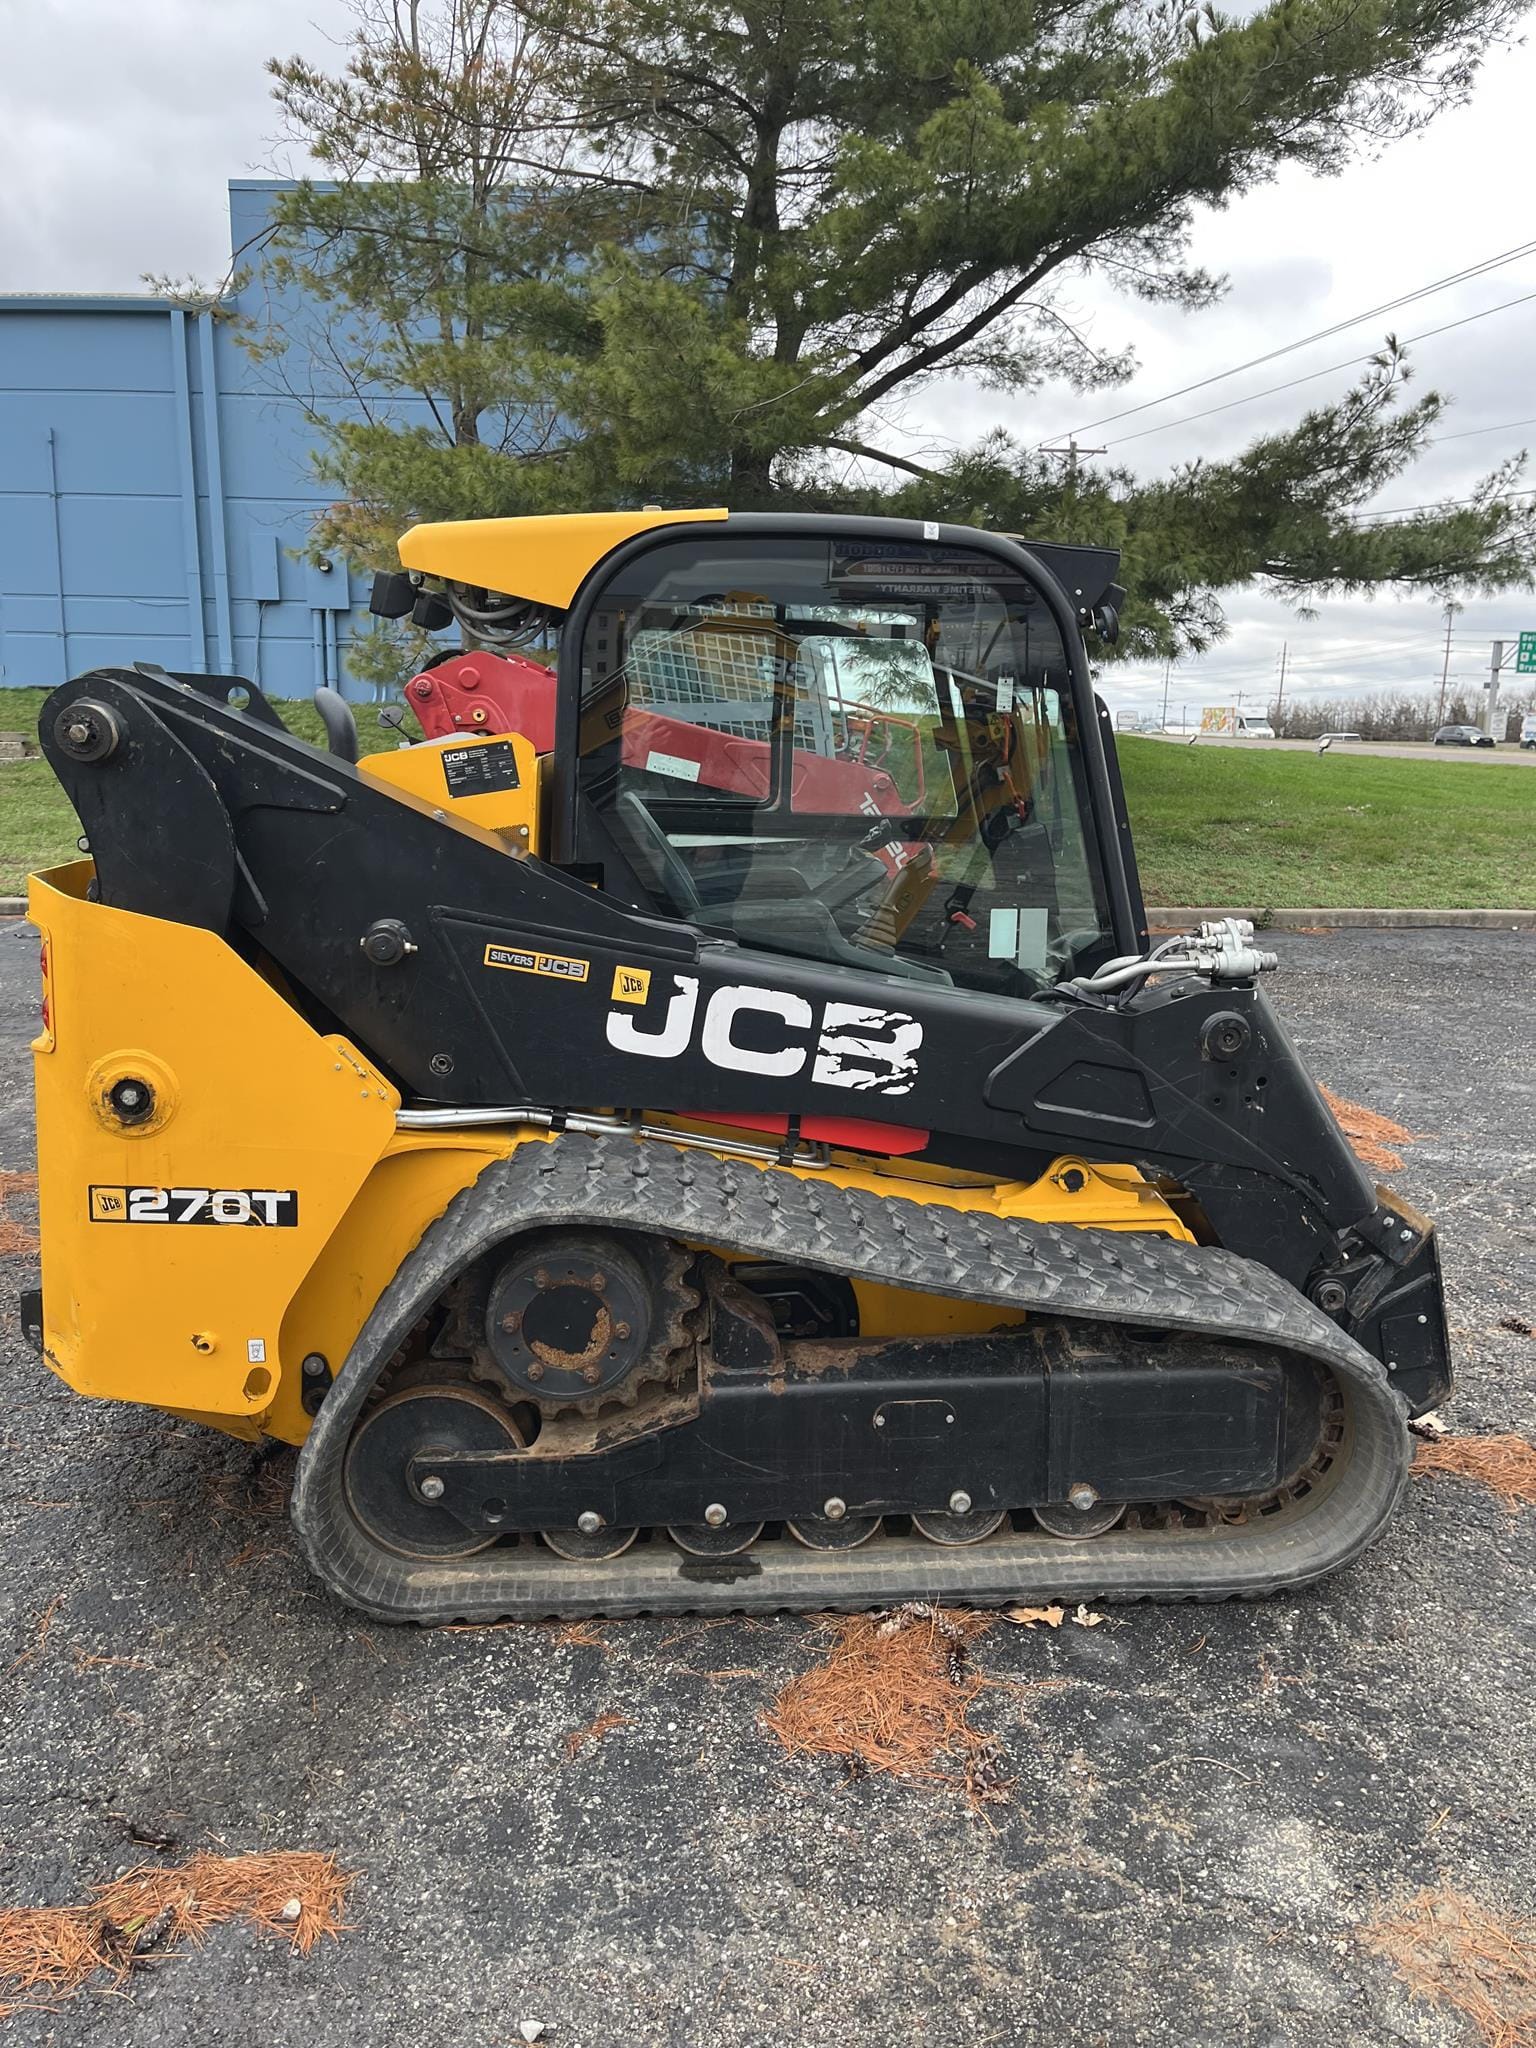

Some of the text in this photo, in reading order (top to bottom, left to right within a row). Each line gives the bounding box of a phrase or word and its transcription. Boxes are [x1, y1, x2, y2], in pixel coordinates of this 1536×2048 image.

[443, 751, 469, 763] JCB
[490, 950, 585, 978] SIEVERS JCB
[622, 973, 644, 993] JCB
[606, 974, 923, 1096] JCB
[101, 1188, 291, 1224] JCB 270T
